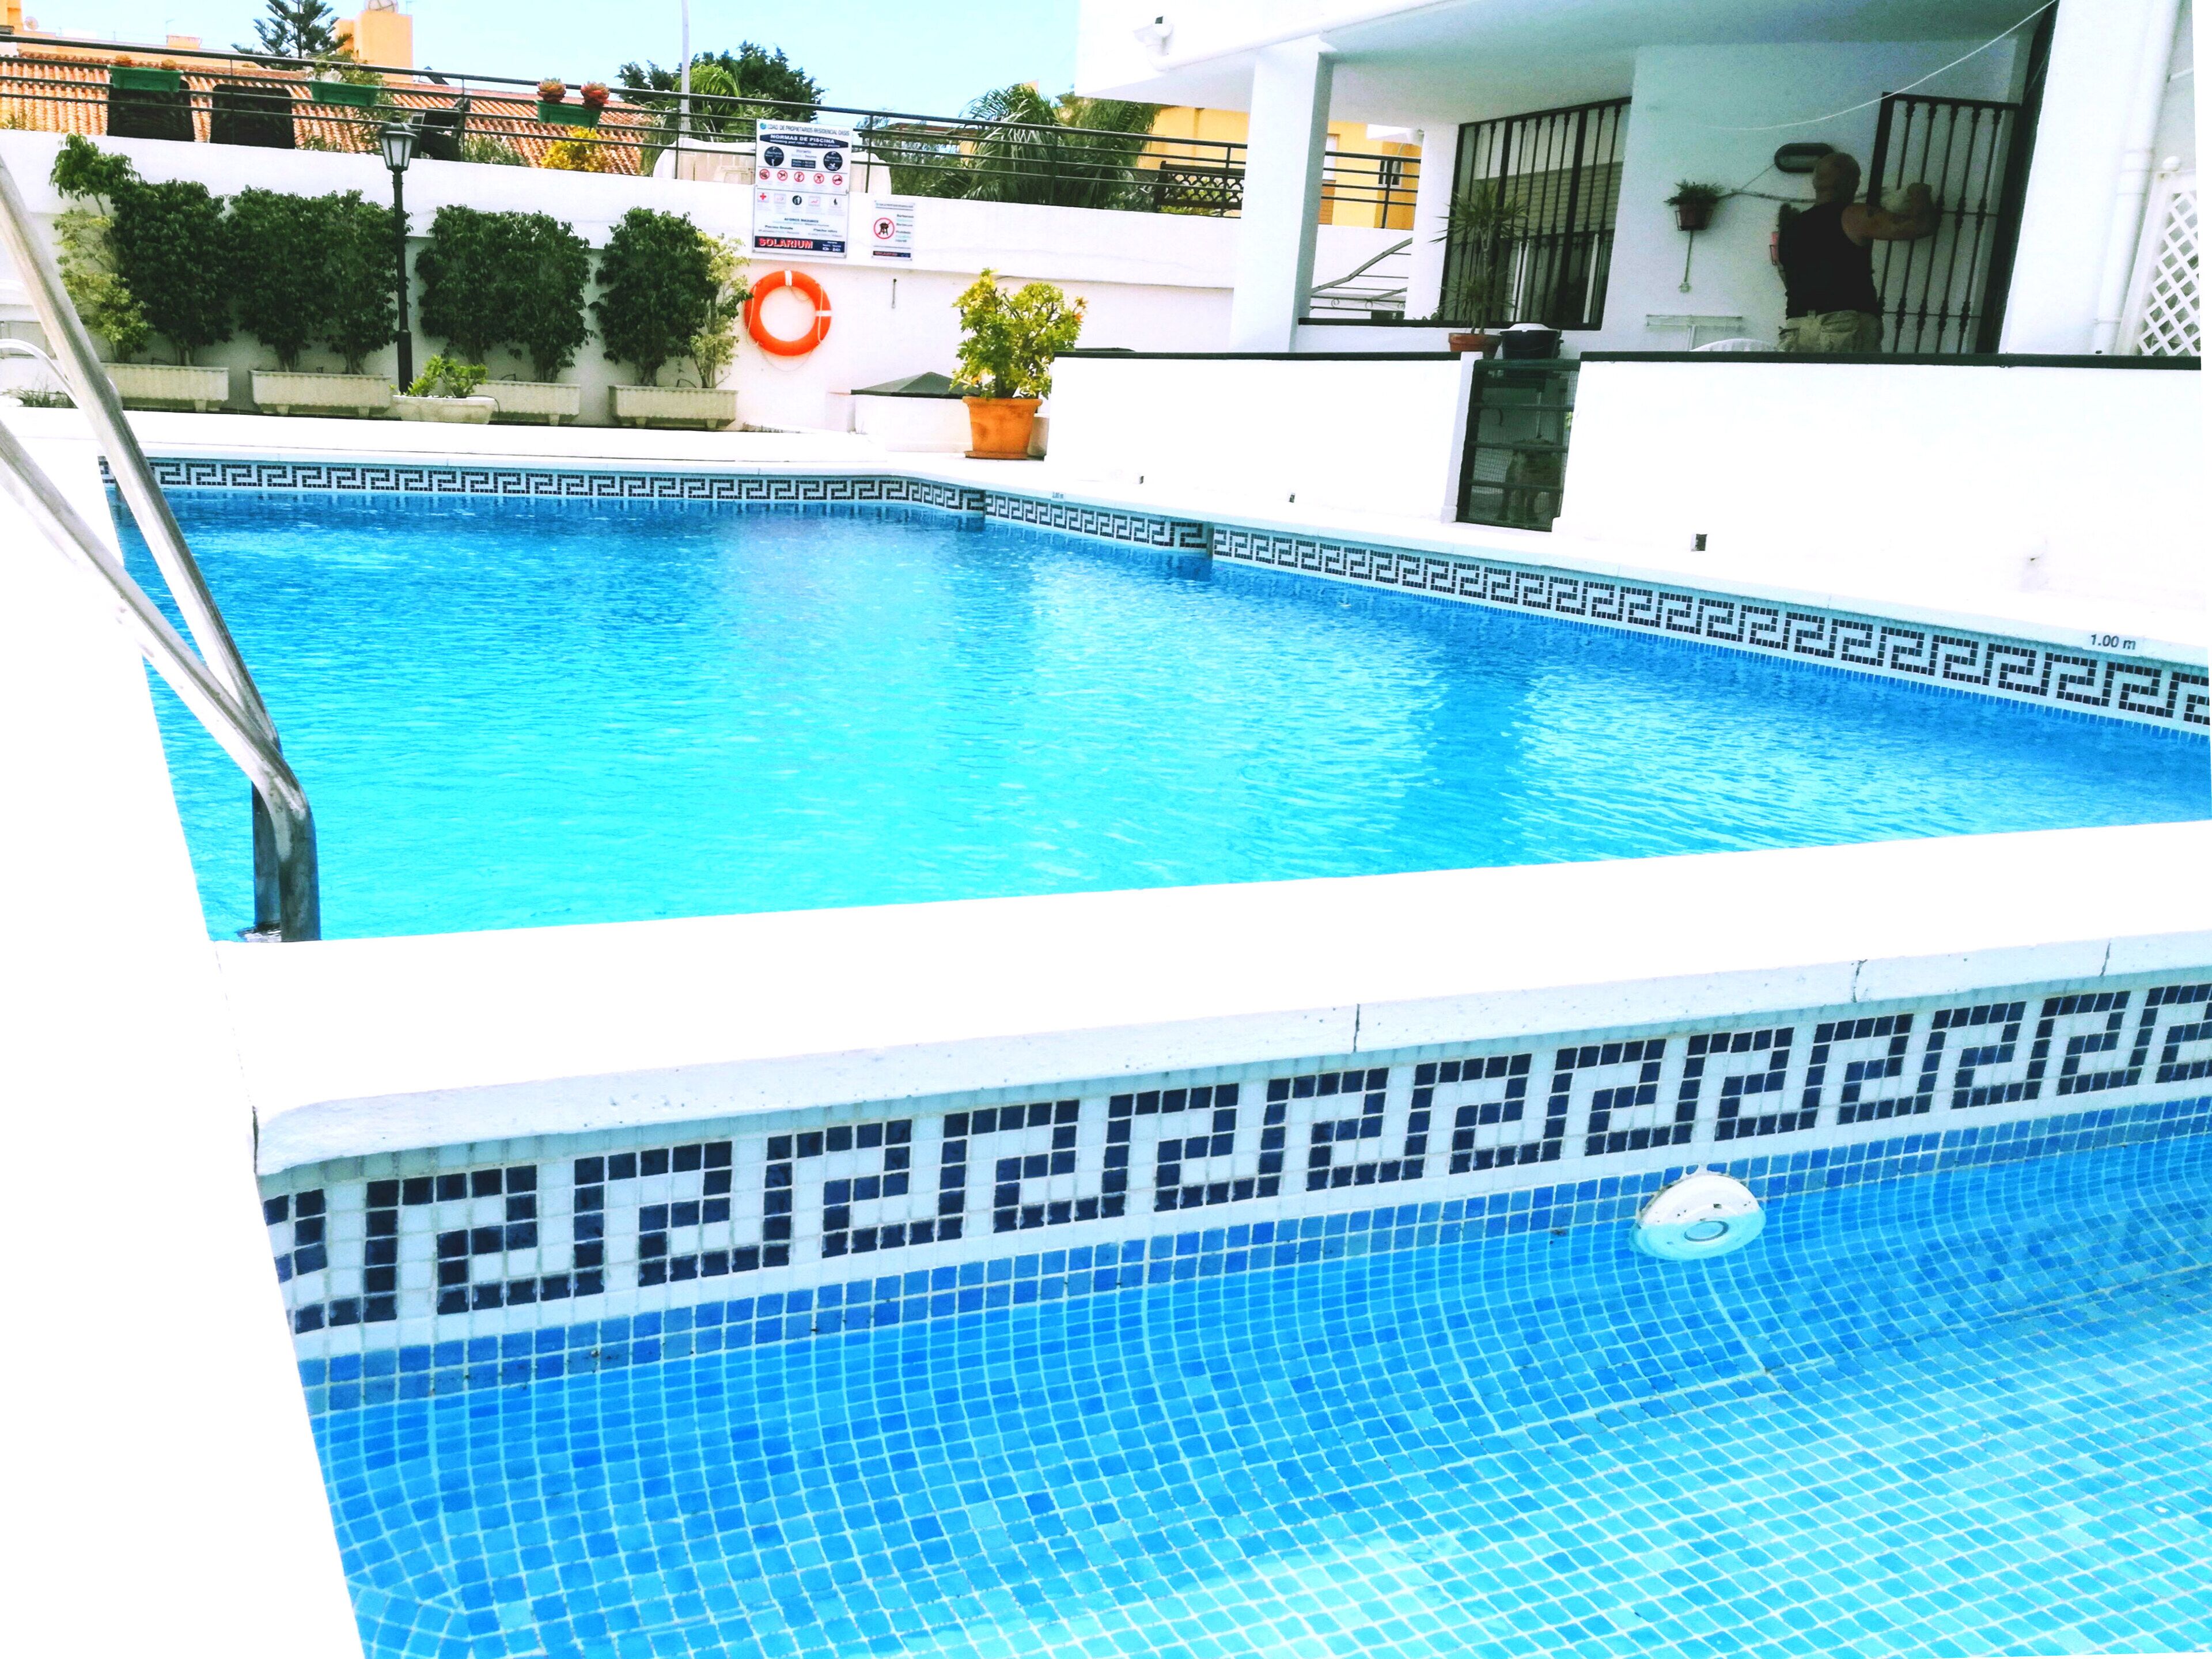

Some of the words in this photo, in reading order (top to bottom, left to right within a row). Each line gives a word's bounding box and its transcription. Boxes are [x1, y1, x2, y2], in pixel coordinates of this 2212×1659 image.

[759, 238, 813, 249] SOLARIUM
[2090, 634, 2119, 648] 1.00
[2123, 639, 2136, 650] m
